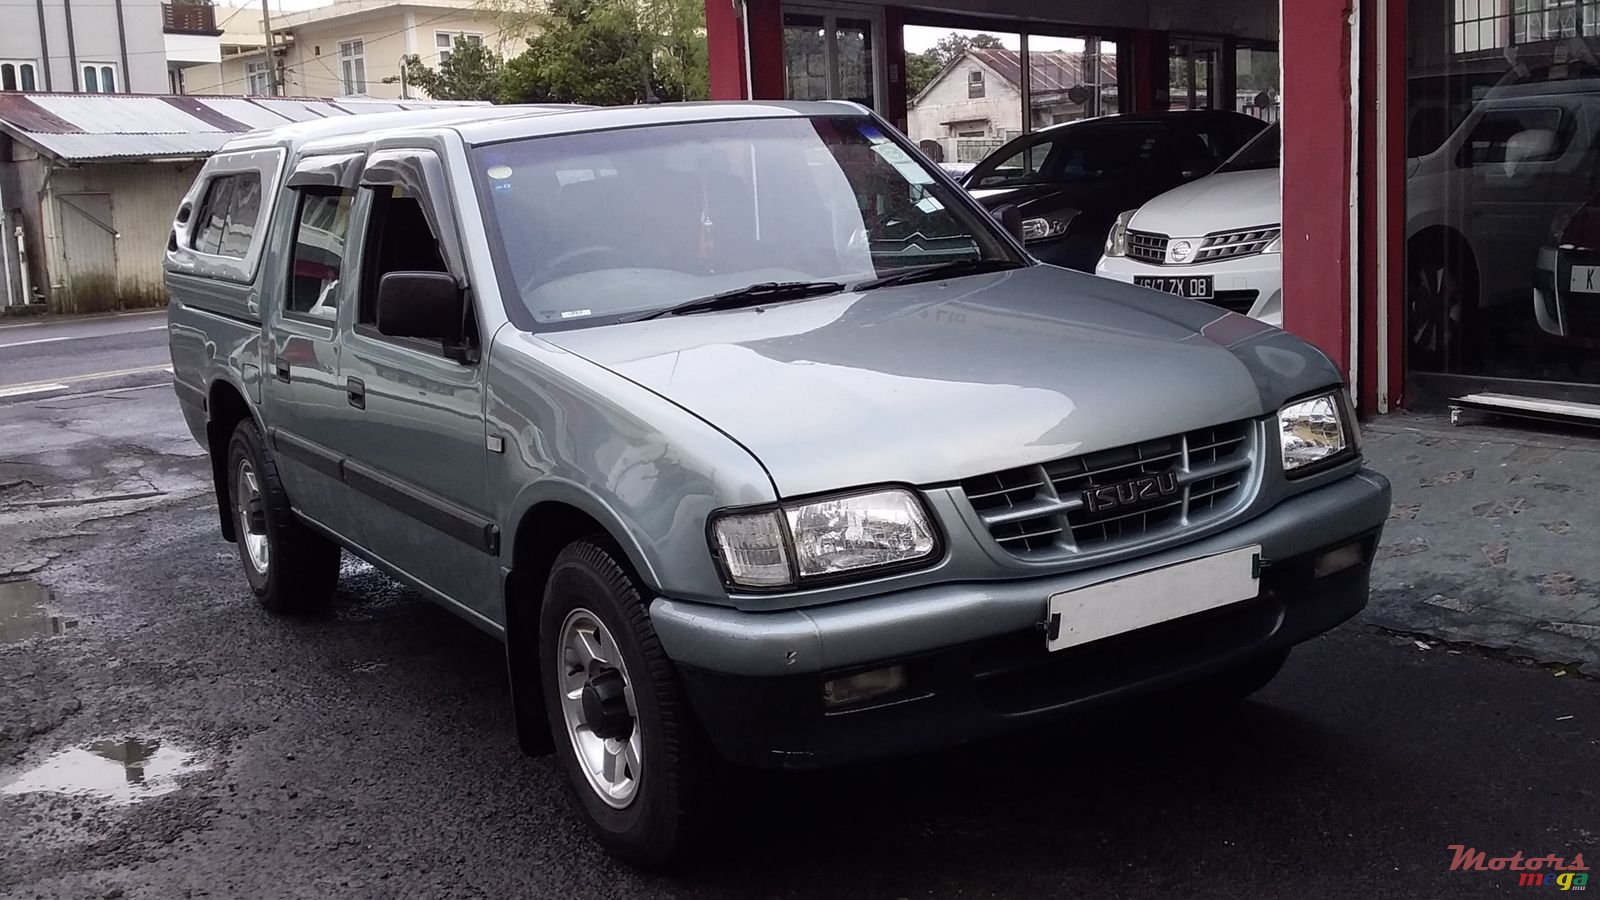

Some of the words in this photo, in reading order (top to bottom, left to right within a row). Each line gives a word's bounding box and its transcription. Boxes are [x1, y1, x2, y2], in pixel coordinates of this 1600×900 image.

[1169, 279, 1184, 296] ZX
[1190, 278, 1207, 296] 08
[1086, 472, 1178, 512] ISUZU
